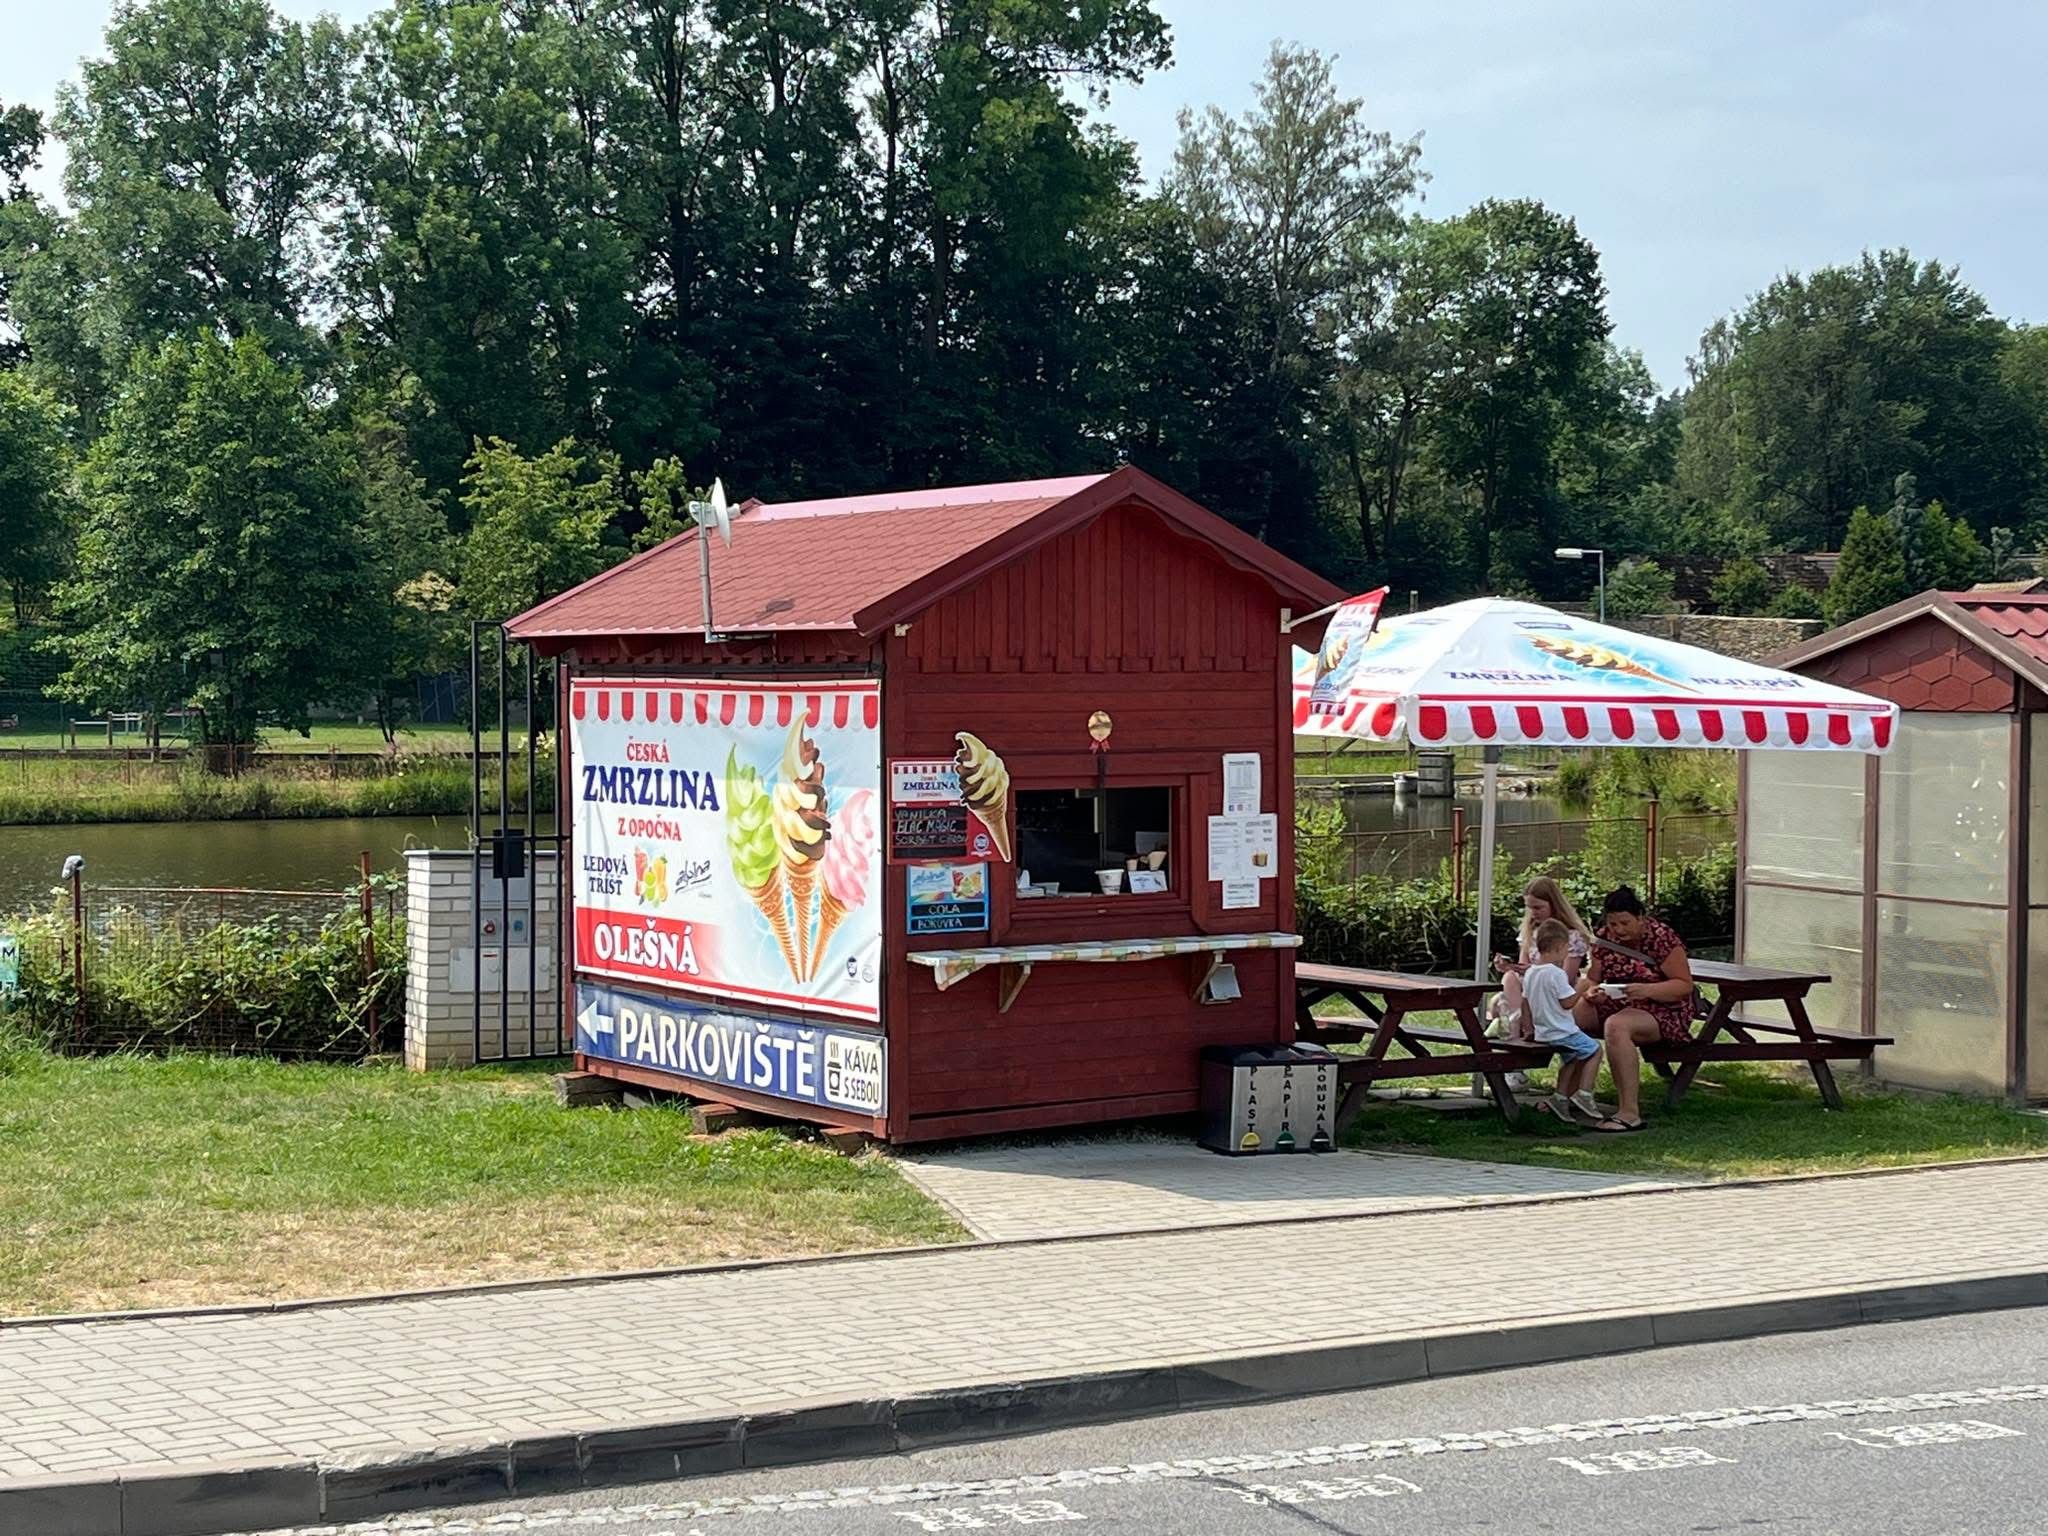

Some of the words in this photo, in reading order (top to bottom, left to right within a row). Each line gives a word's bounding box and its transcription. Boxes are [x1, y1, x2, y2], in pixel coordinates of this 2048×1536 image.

[626, 735, 670, 763] ČESKÁ
[582, 765, 720, 812] ZMRZLINA
[903, 781, 957, 791] ZMRZLINA
[618, 817, 626, 836] Z
[628, 813, 682, 841] OPOČNA
[583, 854, 628, 876] LEDOVÁ
[588, 872, 623, 896] TŘÍŠŤ
[928, 904, 961, 915] COLA
[592, 916, 701, 976] OLEŠNÁ
[619, 1007, 816, 1098] PARKOVIŠTĚ
[844, 1046, 880, 1076] KÁVA
[843, 1076, 850, 1099] S
[851, 1077, 880, 1105] SEBOU
[1247, 1065, 1258, 1133] PLAST
